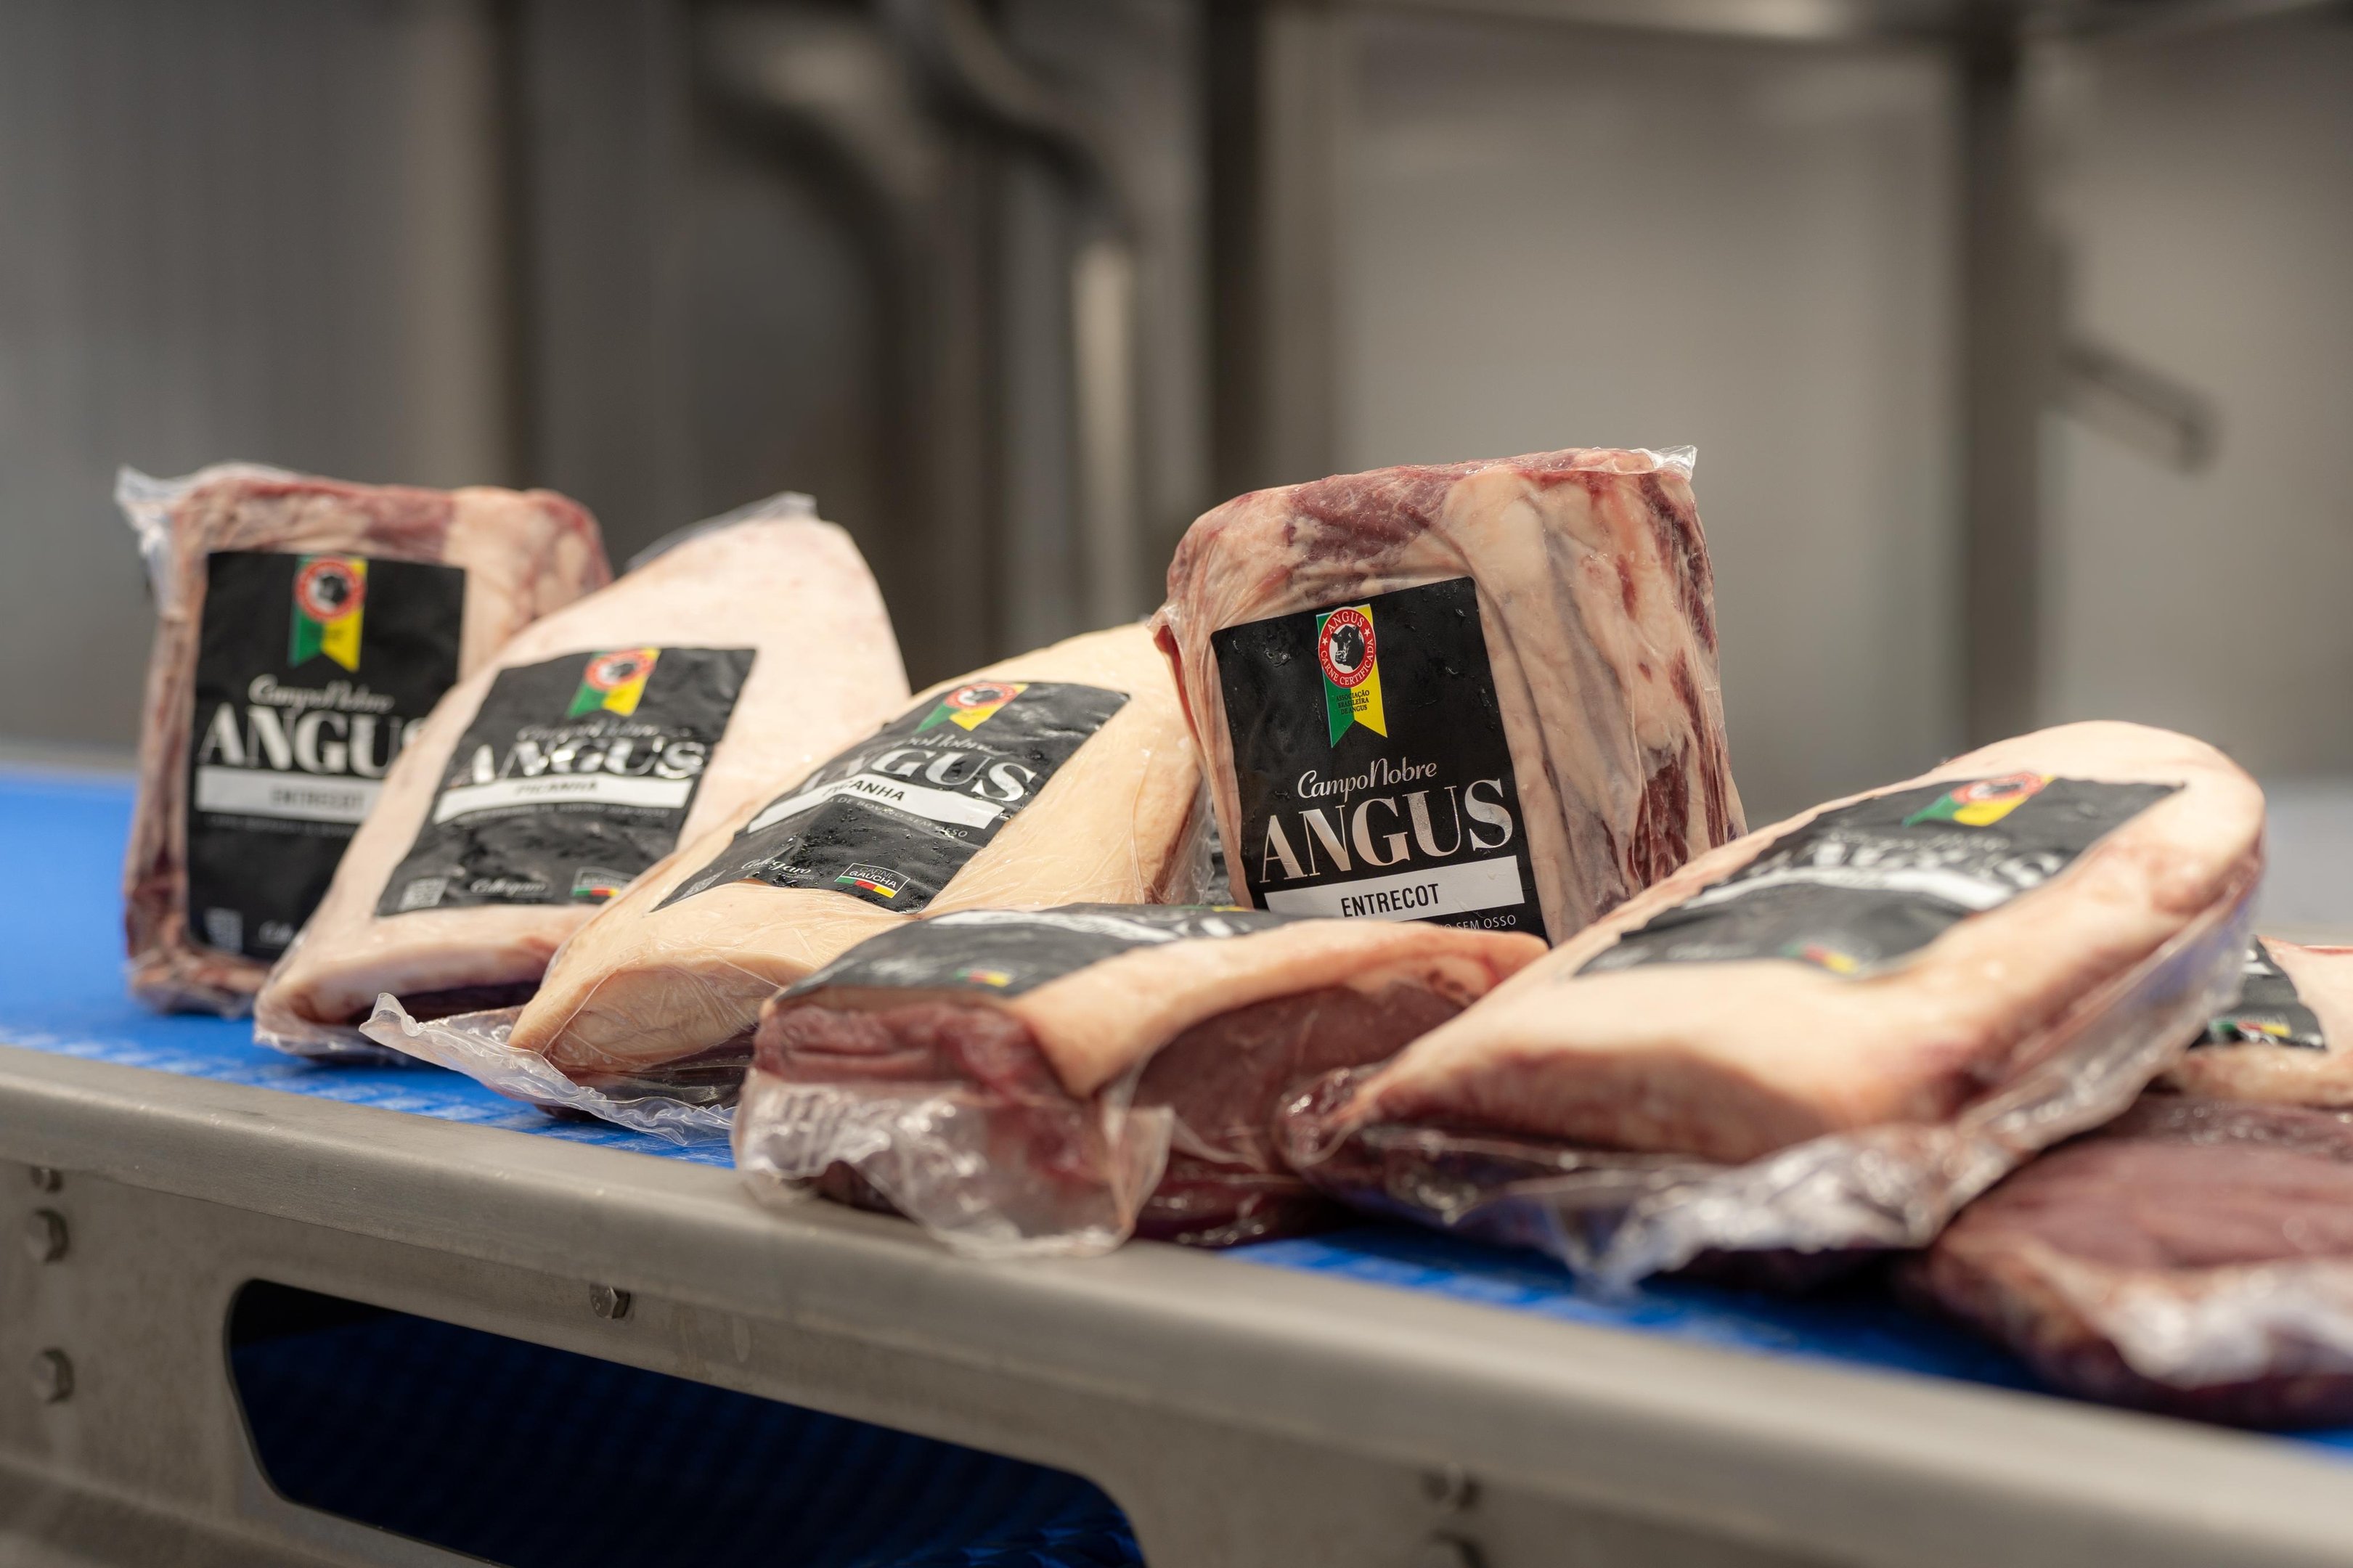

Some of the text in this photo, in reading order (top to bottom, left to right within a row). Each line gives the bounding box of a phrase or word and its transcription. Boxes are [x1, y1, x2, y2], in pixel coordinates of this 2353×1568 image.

[1327, 611, 1365, 634] ANGUS
[1321, 639, 1374, 685] CARNE CERTIFICADA
[1349, 704, 1368, 713] ANGUS
[1260, 779, 1513, 883] ANGUS
[849, 870, 897, 889] GAUCHA
[859, 867, 896, 880] CARNE
[1340, 883, 1440, 918] ENTRECOT
[1484, 915, 1516, 929] OSSO
